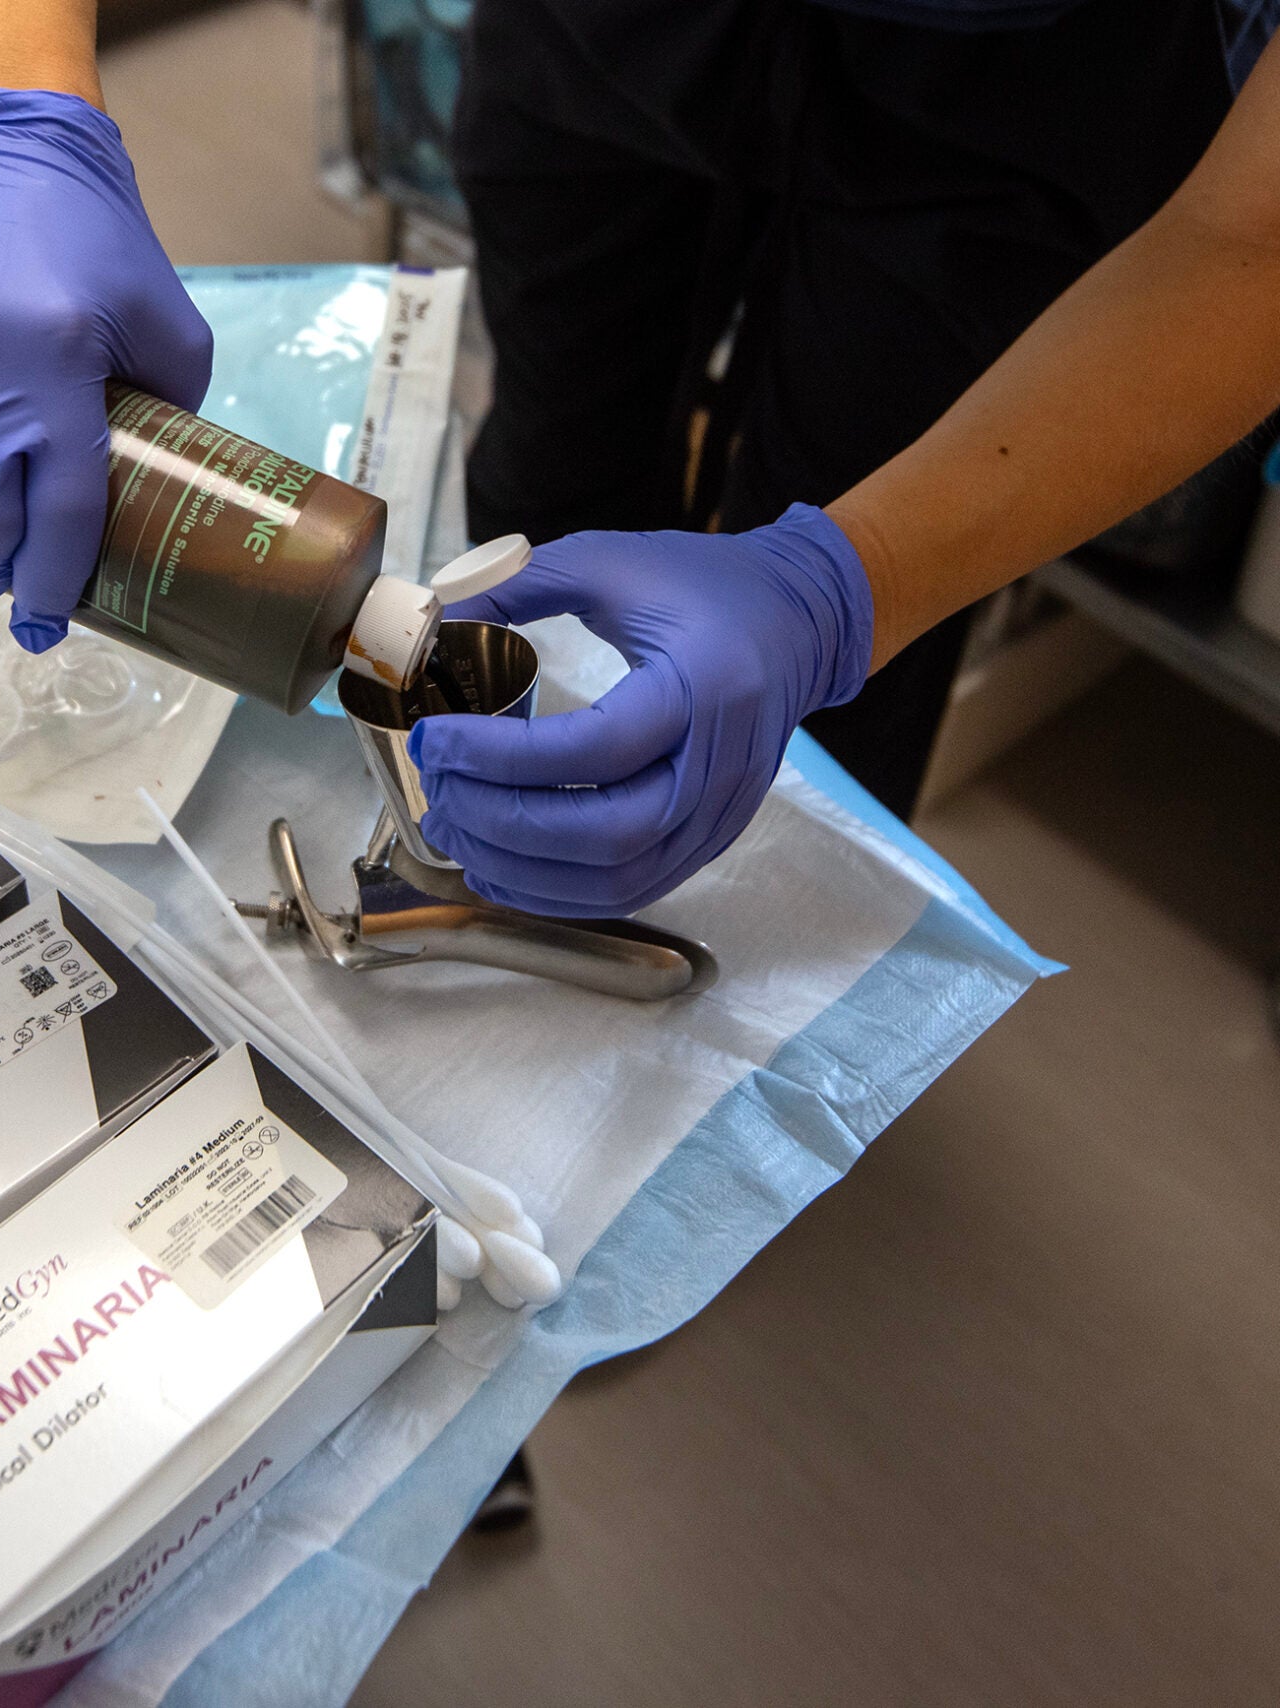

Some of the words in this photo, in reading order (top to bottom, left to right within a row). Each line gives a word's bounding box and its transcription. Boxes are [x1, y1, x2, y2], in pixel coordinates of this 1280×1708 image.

[180, 461, 228, 534] Non-Sterile
[234, 452, 288, 509] olution
[242, 462, 316, 564] ETADINE®
[159, 537, 187, 596] Solution
[135, 1164, 189, 1209] Laminaria
[189, 1152, 203, 1166] #4
[202, 1118, 245, 1154] Medium
[33, 1381, 108, 1453] Dilator
[64, 1455, 274, 1653] LAMINARIA
